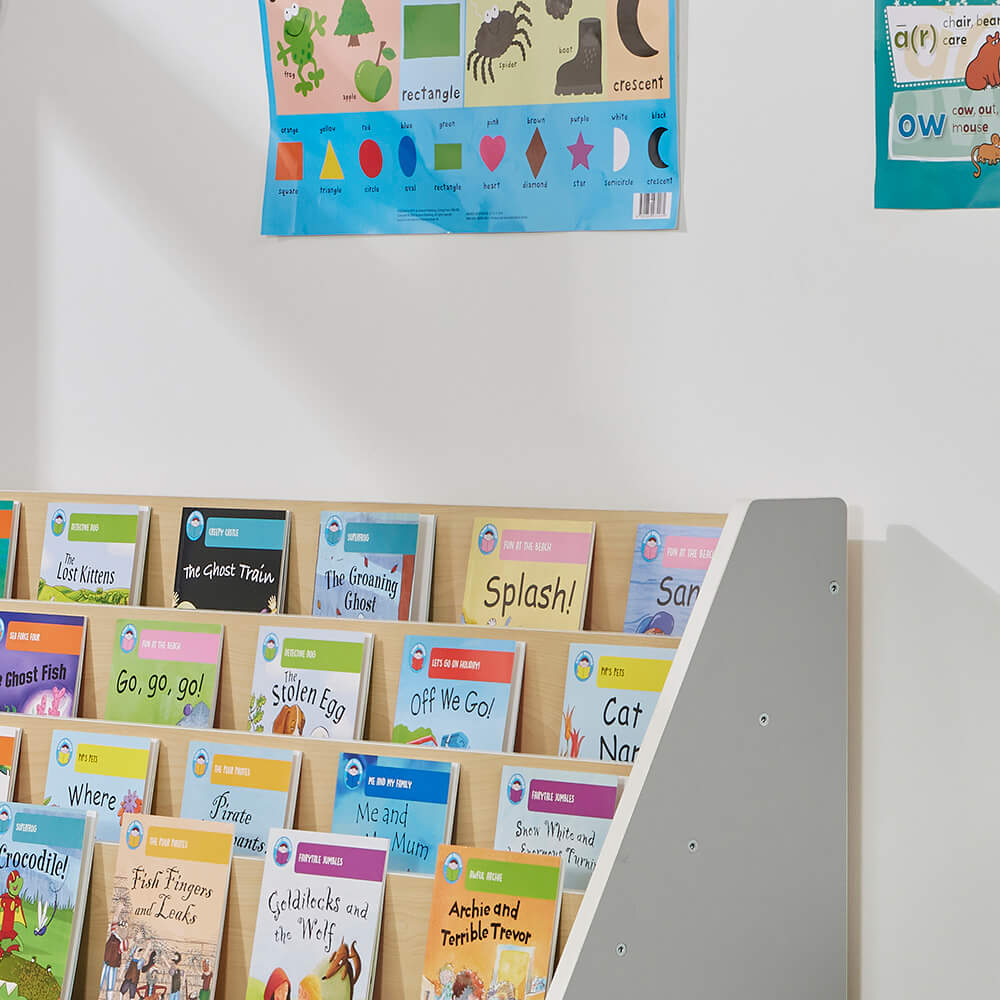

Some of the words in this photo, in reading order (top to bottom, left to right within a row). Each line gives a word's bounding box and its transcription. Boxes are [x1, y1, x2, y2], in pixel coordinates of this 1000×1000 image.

[943, 15, 974, 28] chair,
[943, 36, 967, 45] care
[559, 46, 573, 54] boot
[499, 61, 518, 70] spider
[284, 71, 295, 79] frog
[613, 74, 664, 92] crescent
[343, 93, 356, 101] apple
[402, 85, 461, 102] rectangle
[952, 106, 976, 116] cow,
[978, 104, 999, 114] out,
[487, 119, 499, 128] pink
[570, 115, 590, 124] purple
[898, 114, 946, 138] ow
[952, 123, 988, 132] mouse
[320, 126, 336, 134] yellow
[365, 185, 379, 193] circle
[404, 184, 416, 192] oval
[434, 183, 461, 192] rectangle
[522, 181, 548, 189] diamond
[573, 180, 586, 188] star
[604, 179, 633, 187] semicircle
[647, 177, 673, 185] crescent
[278, 188, 298, 196] square
[320, 187, 342, 195] triangle
[64, 552, 75, 566] The
[57, 561, 77, 580] Lost
[79, 565, 116, 585] Kittens
[183, 563, 201, 580] The
[203, 561, 236, 580] Ghost
[239, 563, 276, 584] Train
[324, 569, 344, 590] The
[348, 566, 399, 600] Groaning
[344, 591, 377, 613] Ghost
[483, 572, 577, 617] Splash!
[5, 665, 38, 688] Ghost
[42, 663, 67, 681] Fish
[284, 671, 298, 685] The
[116, 669, 142, 696] Go,
[147, 673, 172, 698] go,
[177, 673, 205, 701] go!
[272, 679, 318, 707] Stolen
[319, 688, 347, 724] Egg
[410, 685, 436, 717] Off
[441, 687, 461, 711] We
[464, 690, 496, 720] Go!
[602, 696, 643, 729] Cat
[68, 783, 117, 811] Where
[209, 790, 252, 826] Pirate
[355, 802, 379, 824] Me
[382, 804, 409, 828] and
[515, 819, 540, 839] Snow
[543, 819, 575, 842] White
[576, 829, 596, 847] and
[391, 833, 429, 861] Mum
[131, 866, 160, 891] Fish
[163, 866, 214, 900] Fingers
[134, 902, 152, 917] and
[154, 893, 198, 926] Leaks
[268, 886, 341, 921] Goldilocks
[346, 902, 370, 920] and
[448, 897, 491, 920] Archie
[493, 900, 521, 920] and
[274, 925, 293, 945] the
[297, 916, 337, 953] Wolf
[440, 922, 489, 947] Terrible
[490, 922, 532, 945] Trevor
